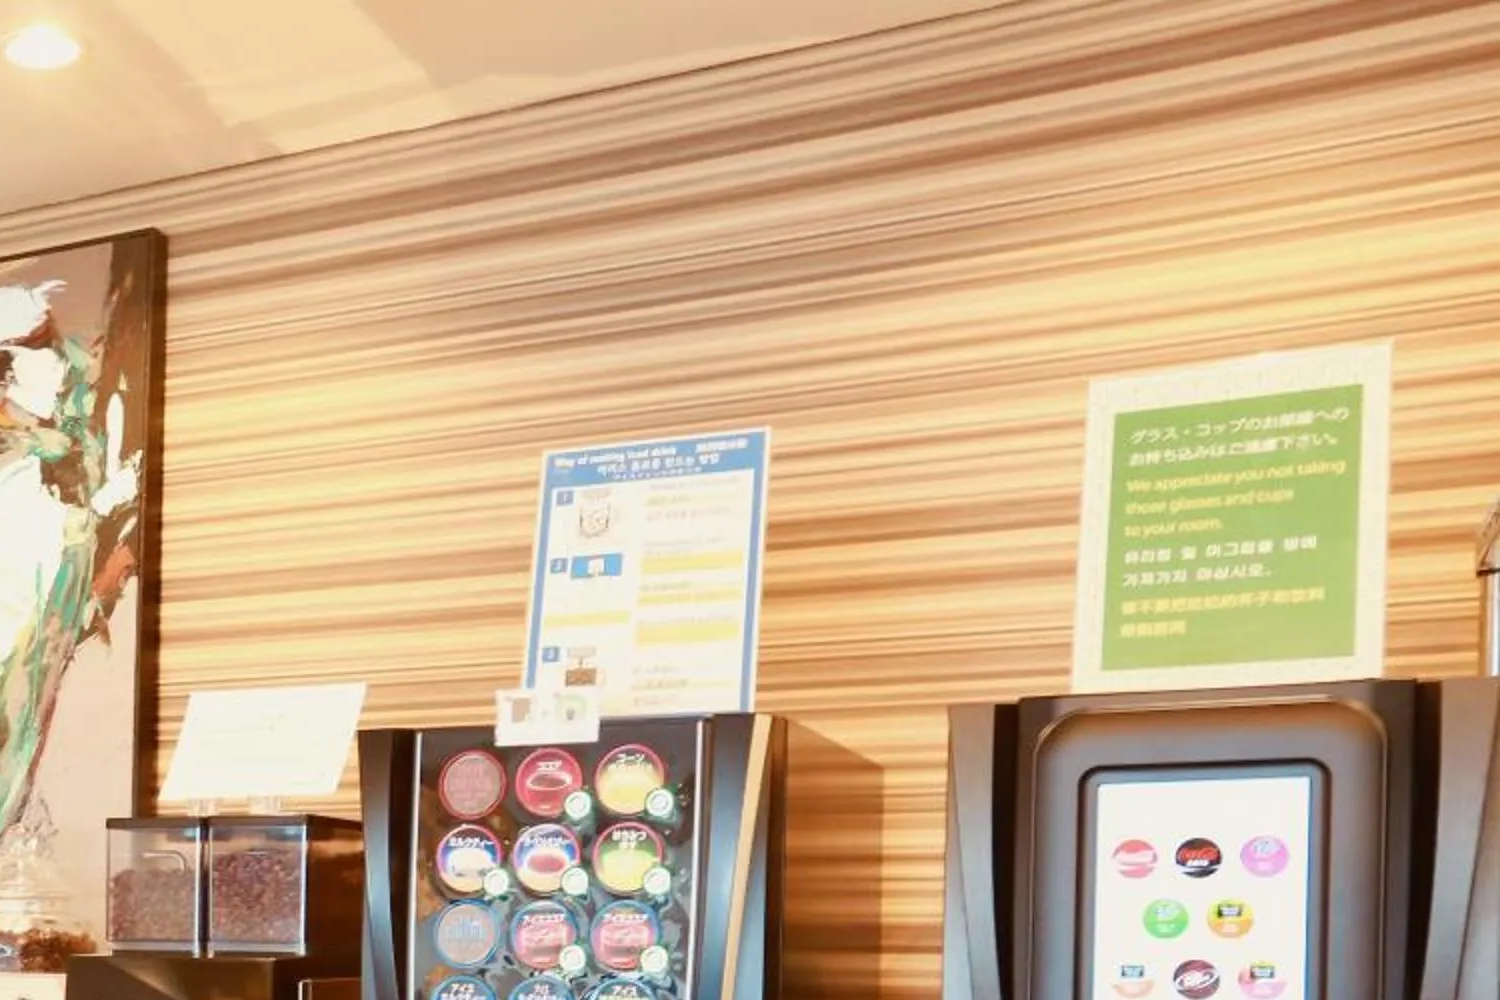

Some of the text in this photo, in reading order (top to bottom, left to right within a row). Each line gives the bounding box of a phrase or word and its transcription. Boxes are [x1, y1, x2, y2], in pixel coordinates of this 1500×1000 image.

[1235, 469, 1264, 485] you
[1297, 460, 1346, 476] taking
[1143, 521, 1175, 539] your
